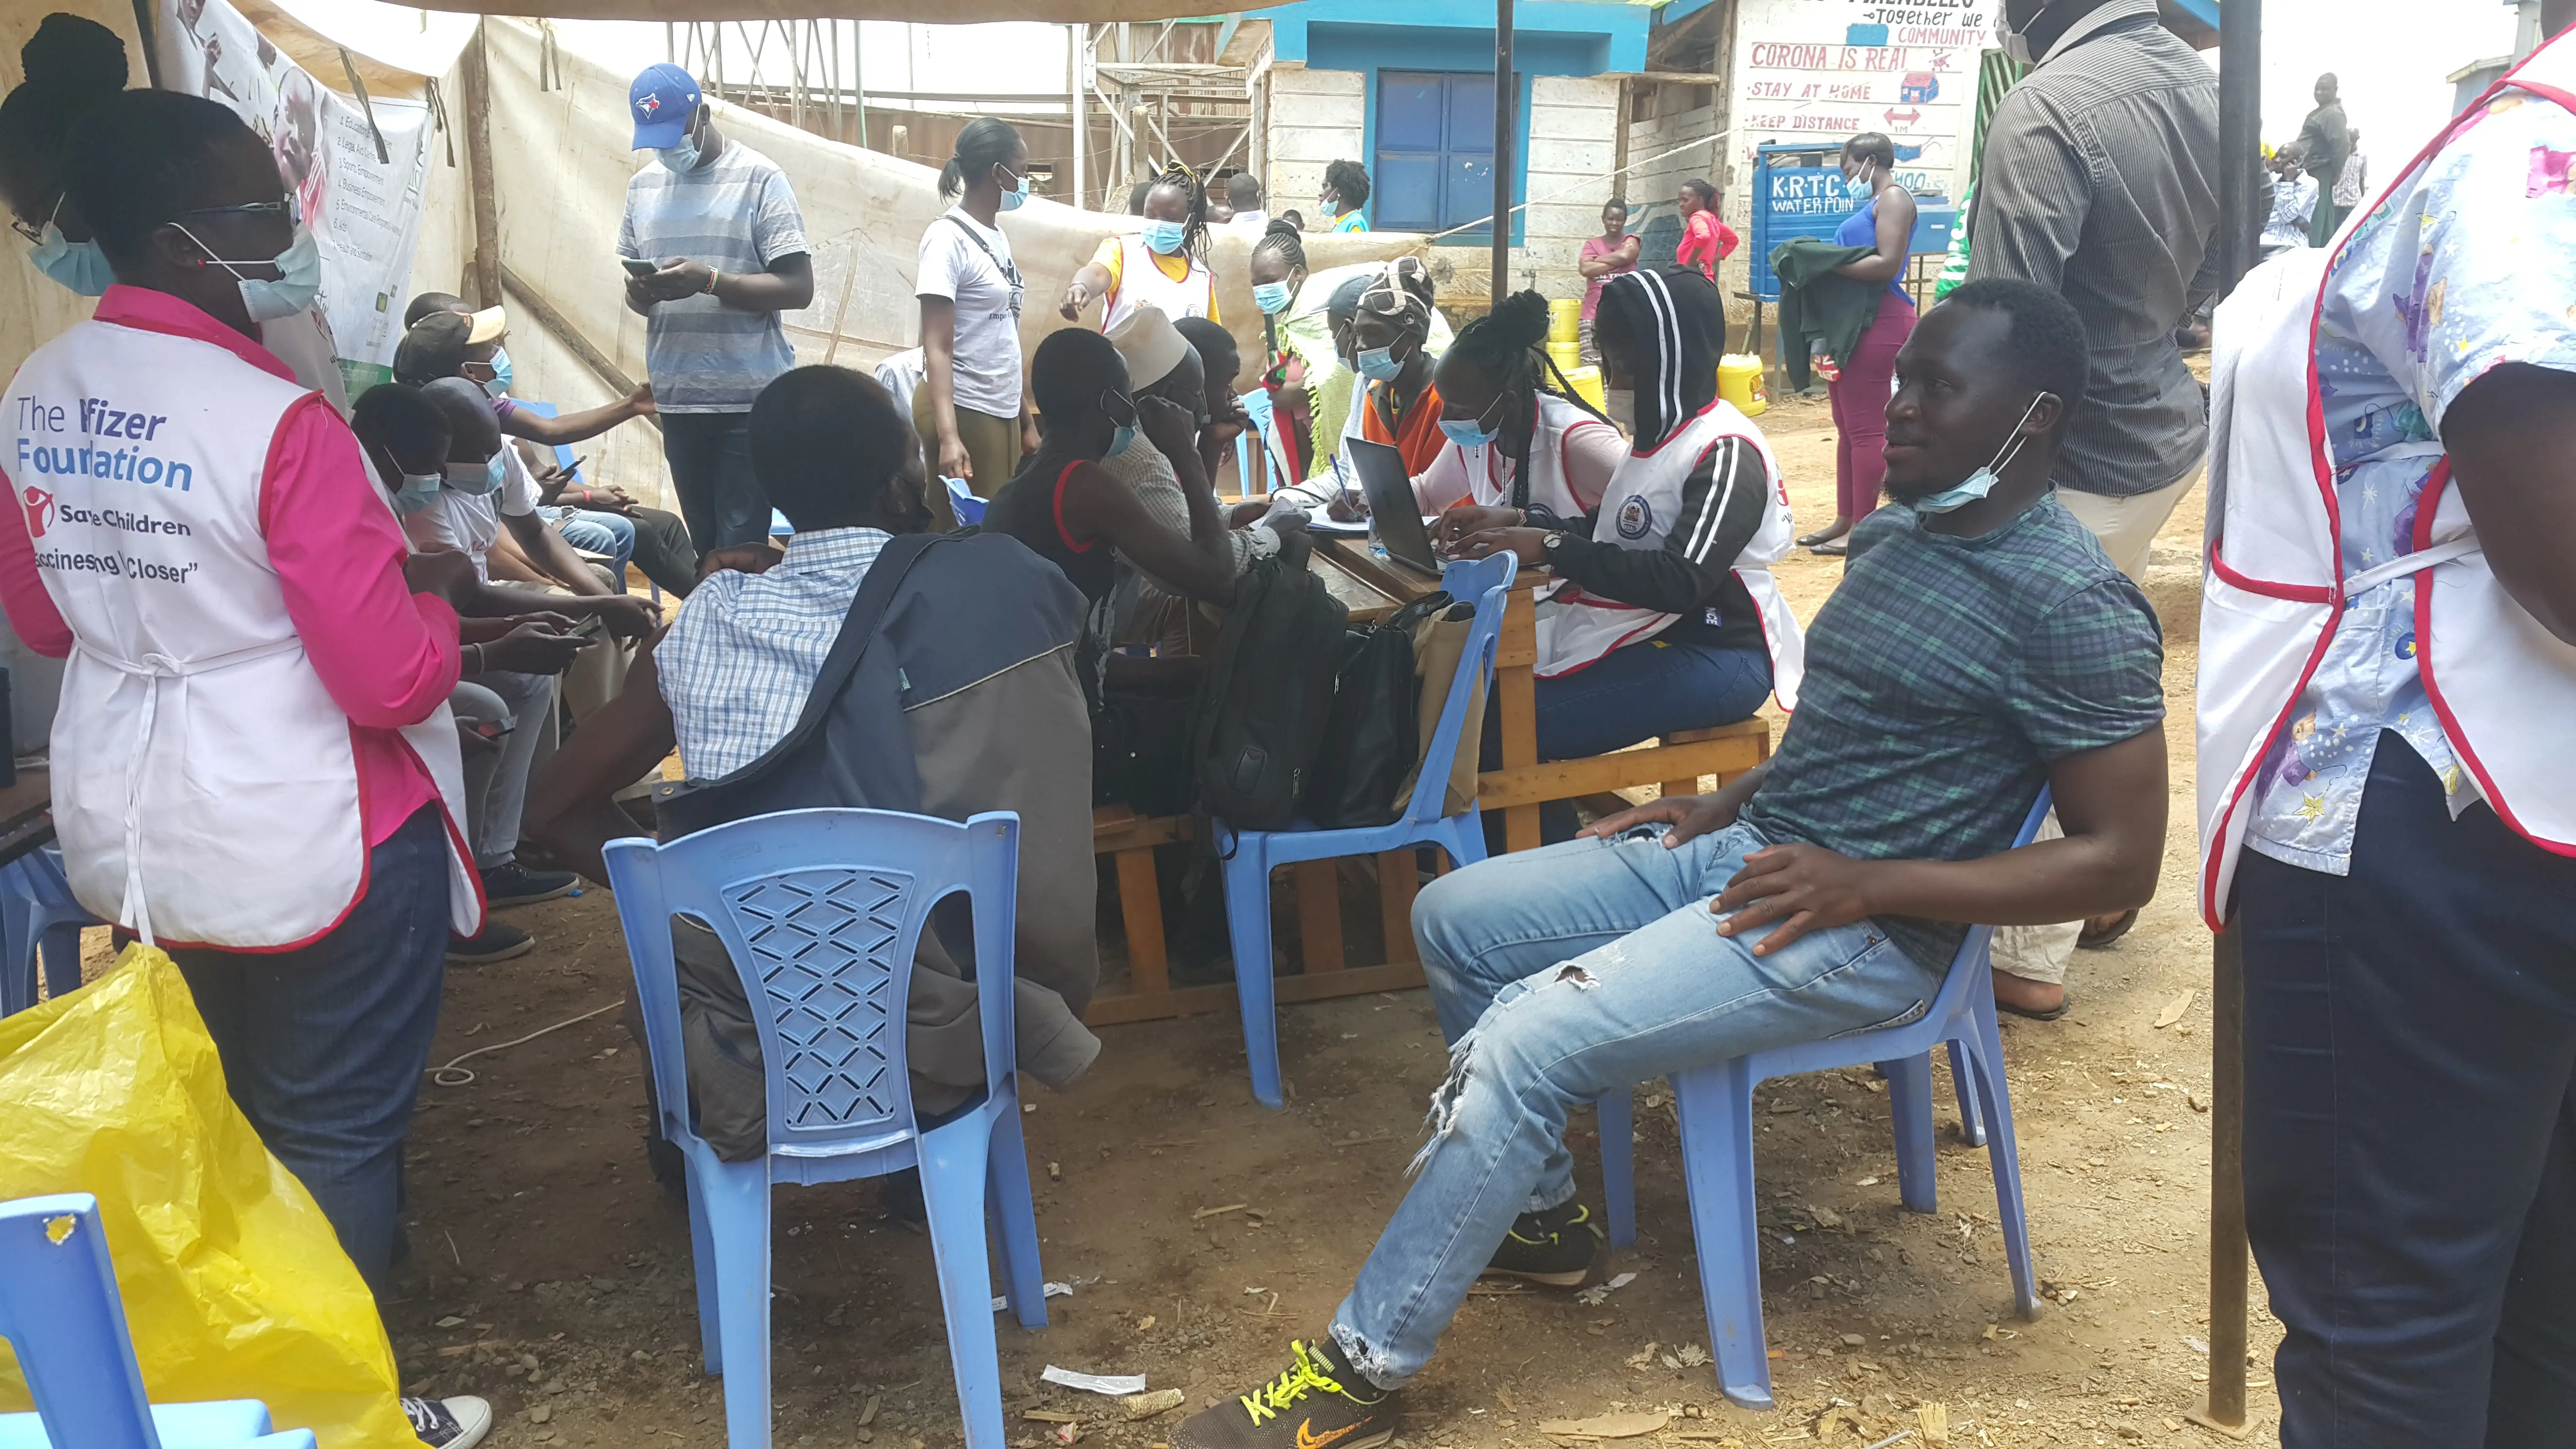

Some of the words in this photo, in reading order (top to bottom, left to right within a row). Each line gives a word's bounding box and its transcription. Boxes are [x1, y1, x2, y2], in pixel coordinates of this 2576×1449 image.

[1876, 9, 1952, 26] Together
[1962, 13, 1982, 27] we
[1898, 27, 1987, 46] COMMUNITY
[1752, 44, 1827, 68] CORONA
[1838, 47, 1857, 69] IS
[1751, 81, 1792, 97] STAY
[1801, 84, 1822, 97] AT
[1829, 84, 1871, 100] HOME
[1750, 114, 1786, 128] KEEP
[1792, 114, 1860, 130] DISTANCE
[1772, 197, 1822, 214] WATER
[17, 396, 64, 432] The
[102, 509, 192, 536] Children
